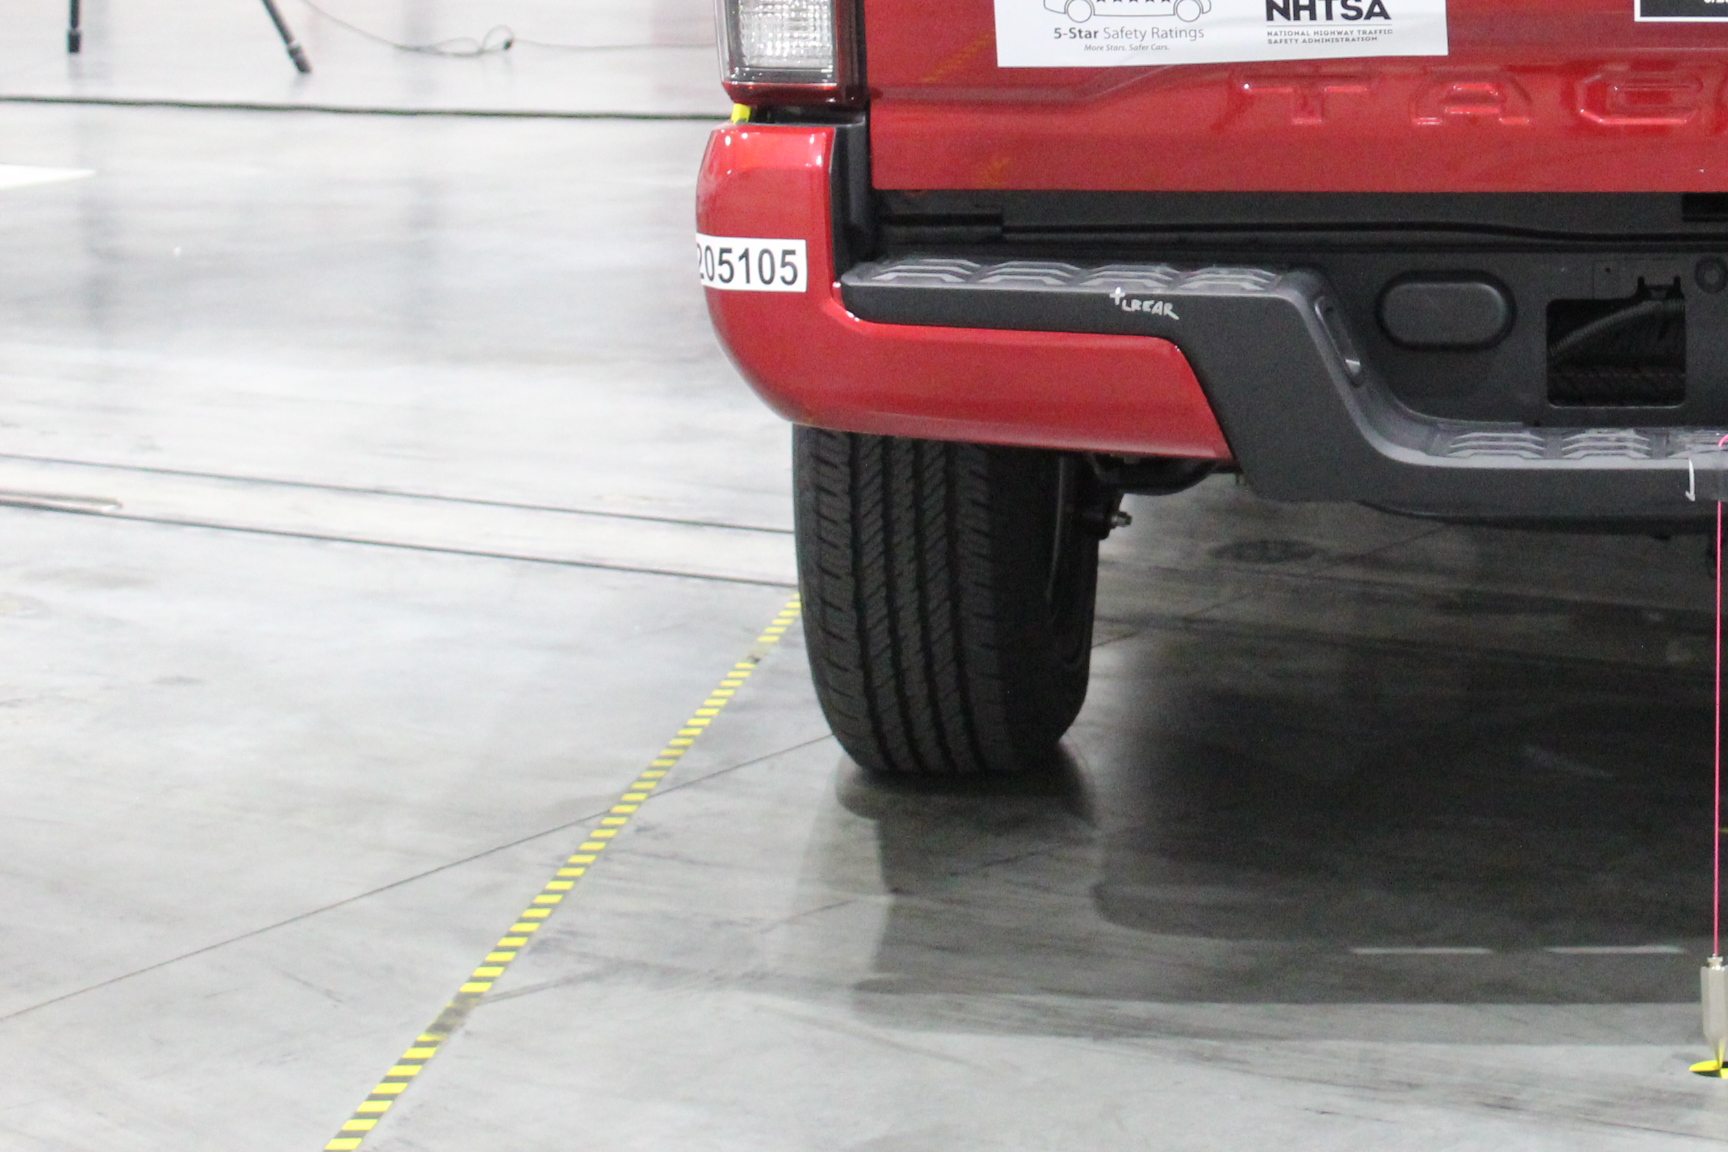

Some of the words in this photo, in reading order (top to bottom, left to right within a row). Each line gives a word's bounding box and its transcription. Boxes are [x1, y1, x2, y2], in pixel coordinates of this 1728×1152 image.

[1053, 26, 1099, 40] 5-Star
[1103, 26, 1147, 42] Safety
[1151, 26, 1205, 42] Ratings
[1129, 43, 1149, 51] Safer
[1151, 43, 1170, 51] Cars.
